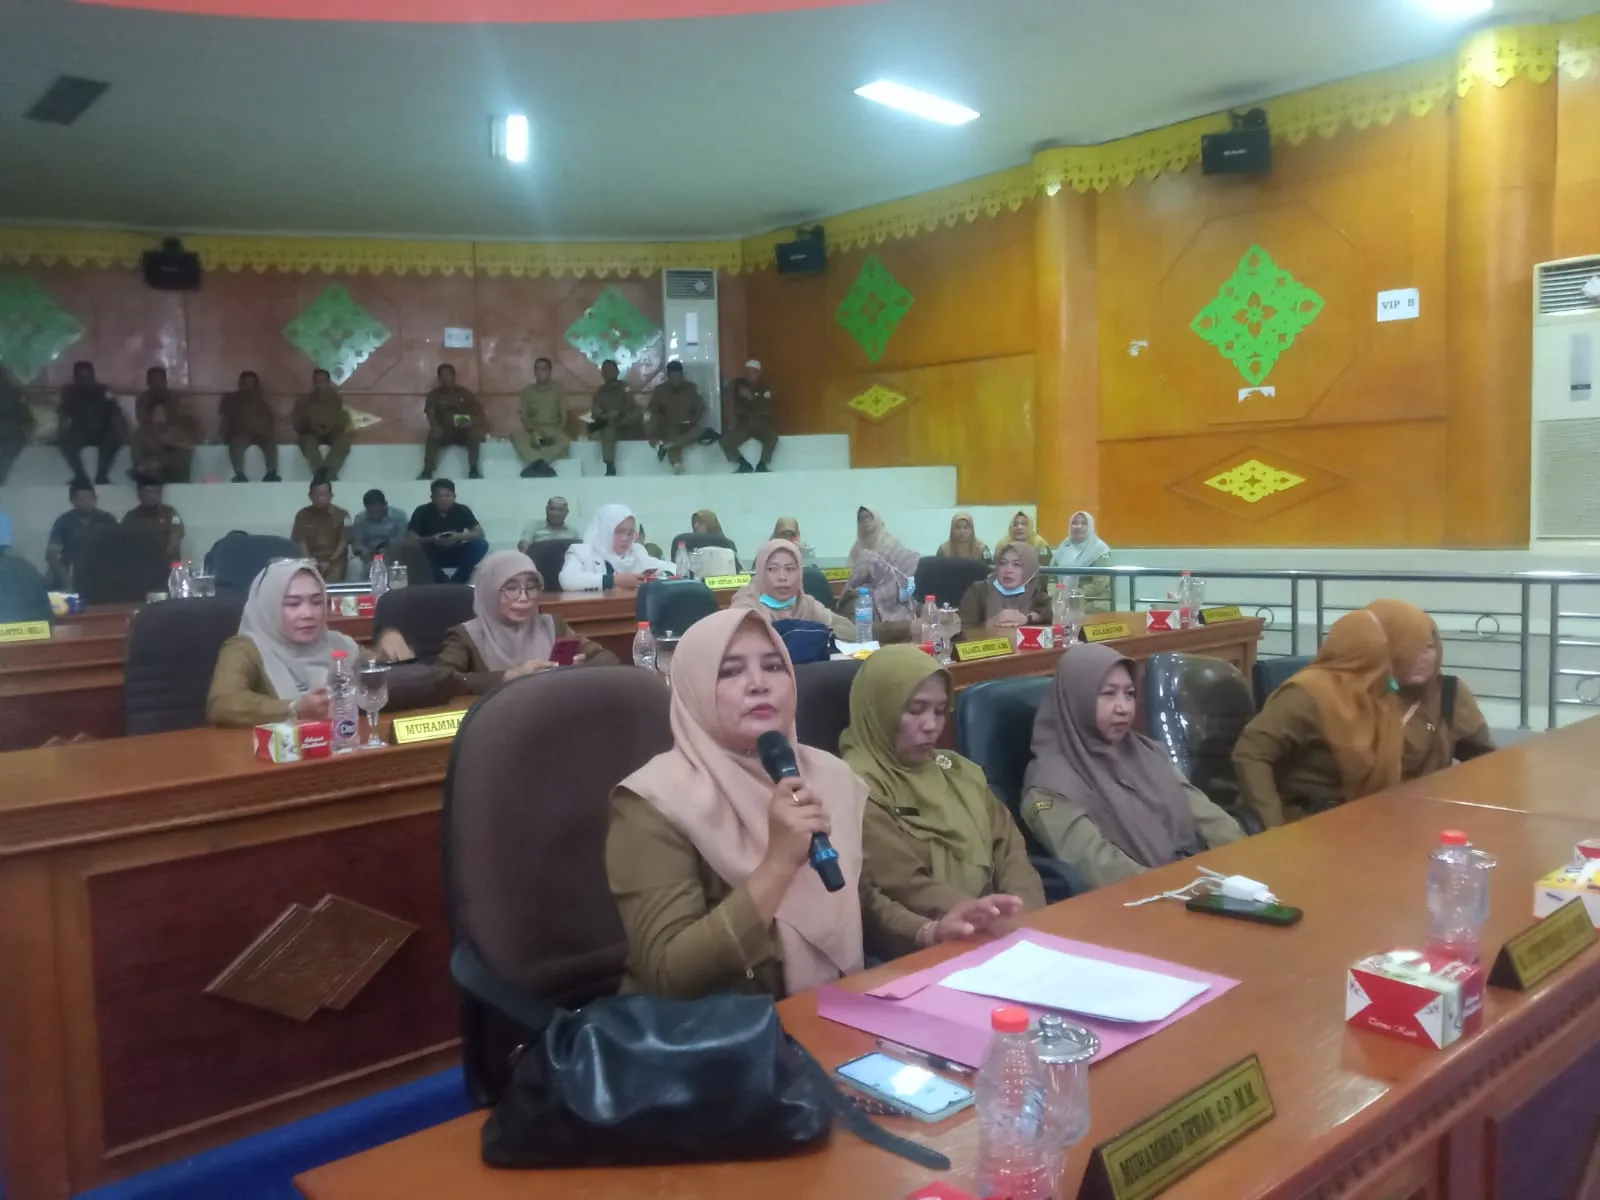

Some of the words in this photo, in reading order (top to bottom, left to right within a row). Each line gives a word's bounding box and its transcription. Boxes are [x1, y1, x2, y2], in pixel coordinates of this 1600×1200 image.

[1382, 300, 1400, 310] VIP
[1407, 298, 1415, 307] B
[1119, 1127, 1186, 1188] MUHAMMAD
